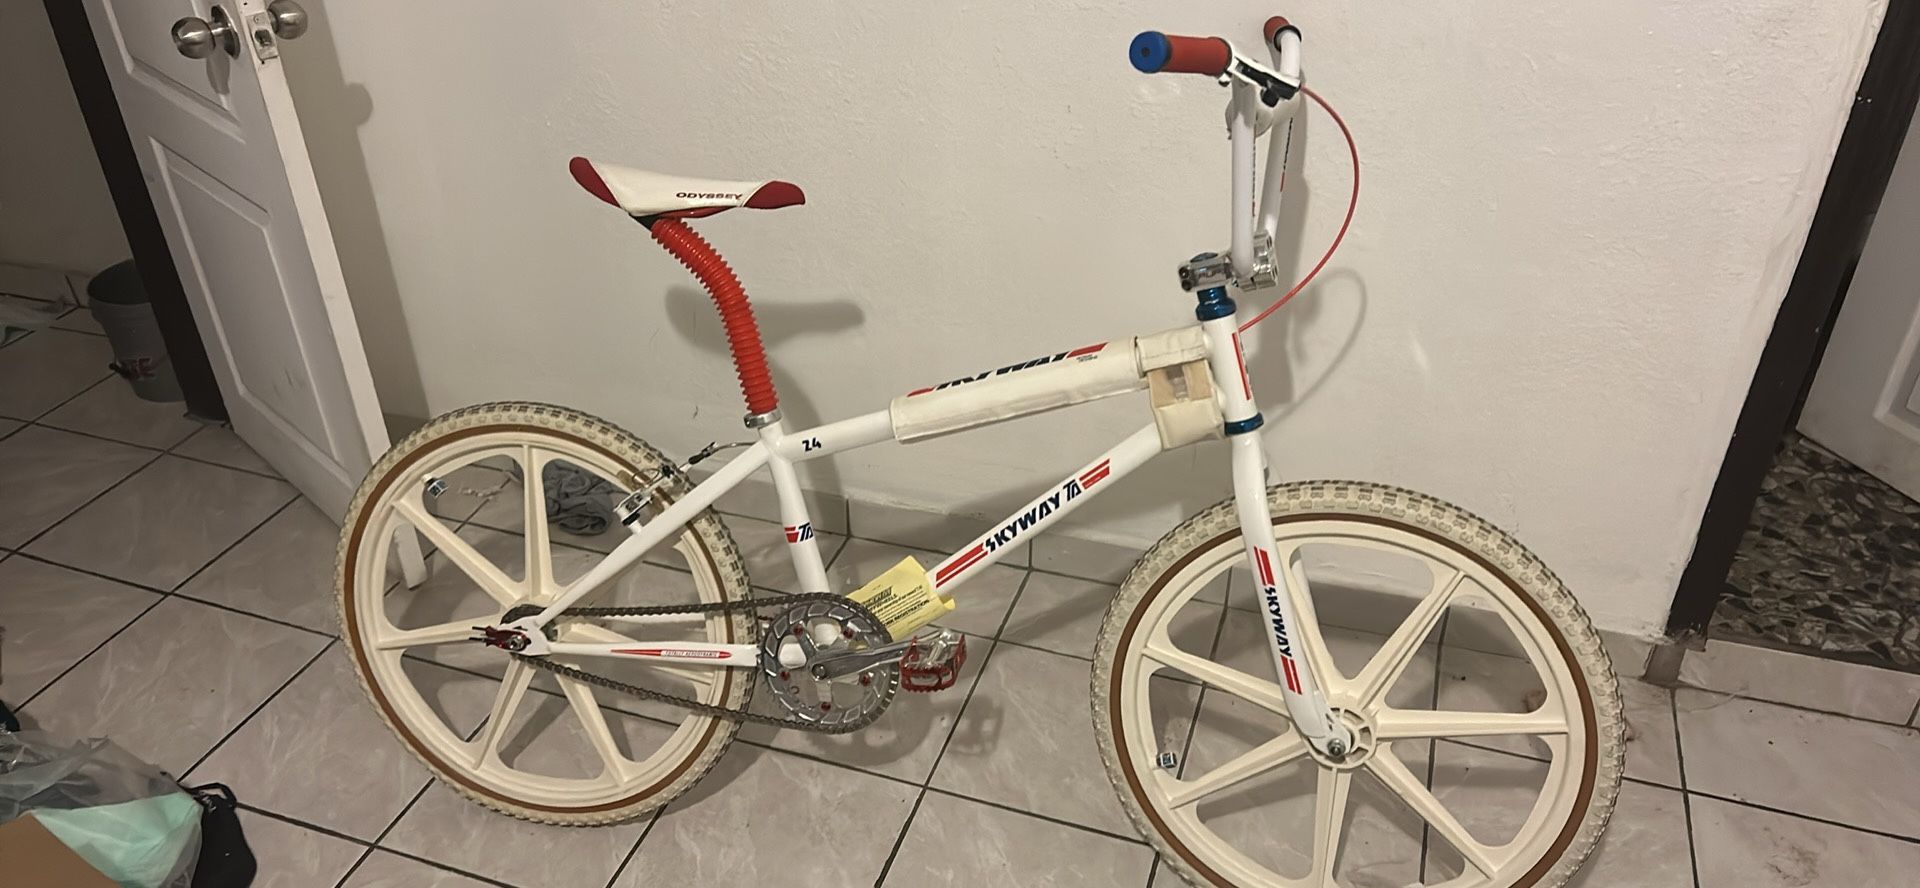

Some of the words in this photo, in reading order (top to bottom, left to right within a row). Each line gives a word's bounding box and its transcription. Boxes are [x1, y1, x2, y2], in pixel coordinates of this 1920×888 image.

[676, 192, 743, 200] ODYSSEY
[802, 437, 822, 452] 24
[985, 491, 1060, 553] SKYWAY
[1062, 479, 1082, 501] TA
[1264, 587, 1292, 658] SKYWAY
